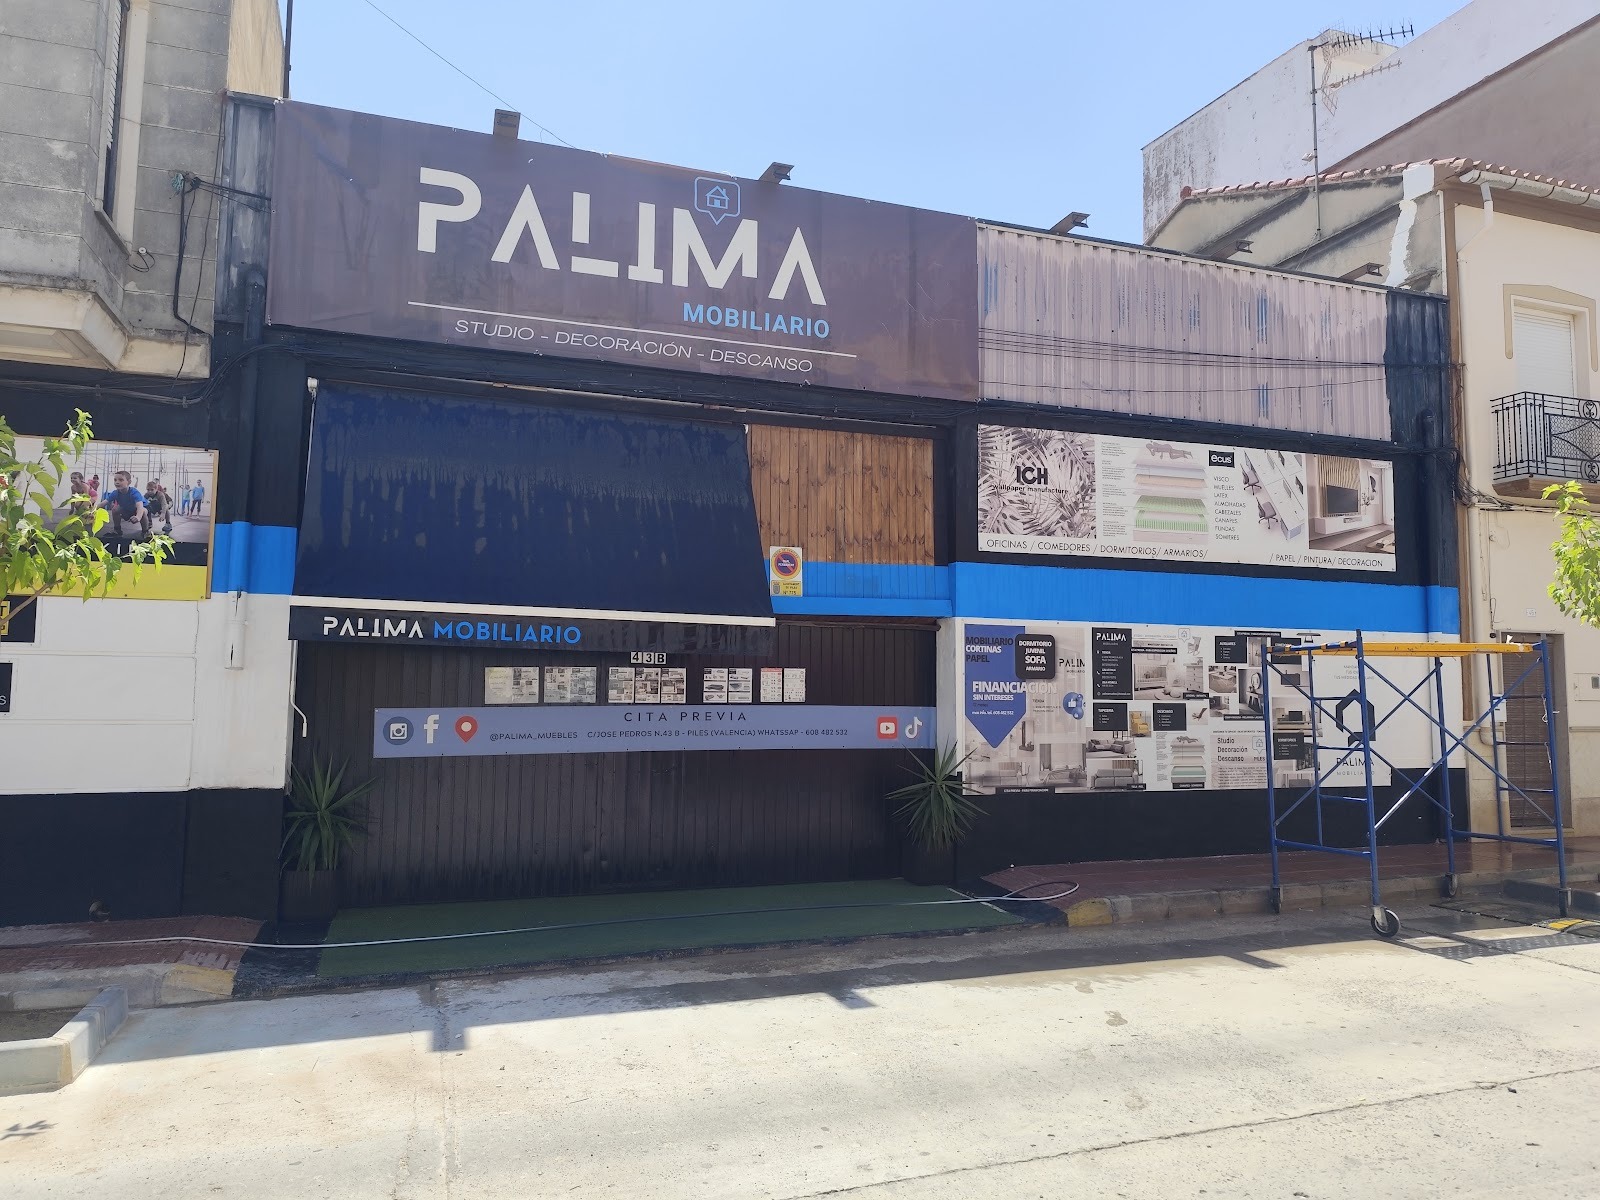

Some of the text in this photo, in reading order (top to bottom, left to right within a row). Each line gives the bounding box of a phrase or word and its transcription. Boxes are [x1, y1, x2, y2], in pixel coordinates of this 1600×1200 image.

[417, 166, 827, 306] PALIMA
[683, 302, 830, 339] MOBILIARIO
[454, 318, 535, 341] STUDIO
[555, 330, 693, 359] DECORACIÓN
[710, 348, 813, 373] DESCANSO
[1210, 454, 1232, 464] ecus
[1016, 465, 1049, 486] ICH
[993, 484, 1069, 494] wallpaper manufacture
[1214, 501, 1247, 509] ALMOHADAS
[1214, 508, 1242, 516] CABEZALES
[986, 538, 1028, 550] OFICINAS
[1037, 541, 1091, 552] COMEDORES
[1275, 554, 1296, 563] PAPEL
[1337, 557, 1383, 567] DECORACION
[323, 616, 582, 645] PALIMA MOBILIARIO
[965, 636, 1014, 646] MOBILIARIO
[1096, 632, 1127, 642] PALIMA
[965, 644, 1002, 654] CORTINAS
[1024, 647, 1046, 655] JUVENIL
[965, 654, 991, 663] PAPEL
[1024, 655, 1047, 664] SOFA
[972, 693, 984, 701] SIN
[624, 711, 747, 723] CITA PREVIA
[489, 731, 578, 742] @PALIMA_MUEBLES
[619, 730, 652, 738] PEDROS
[687, 729, 709, 737] PILES
[710, 729, 756, 738] (VALENCIA)
[1217, 736, 1235, 744] Studio
[1217, 745, 1248, 753] Decoración
